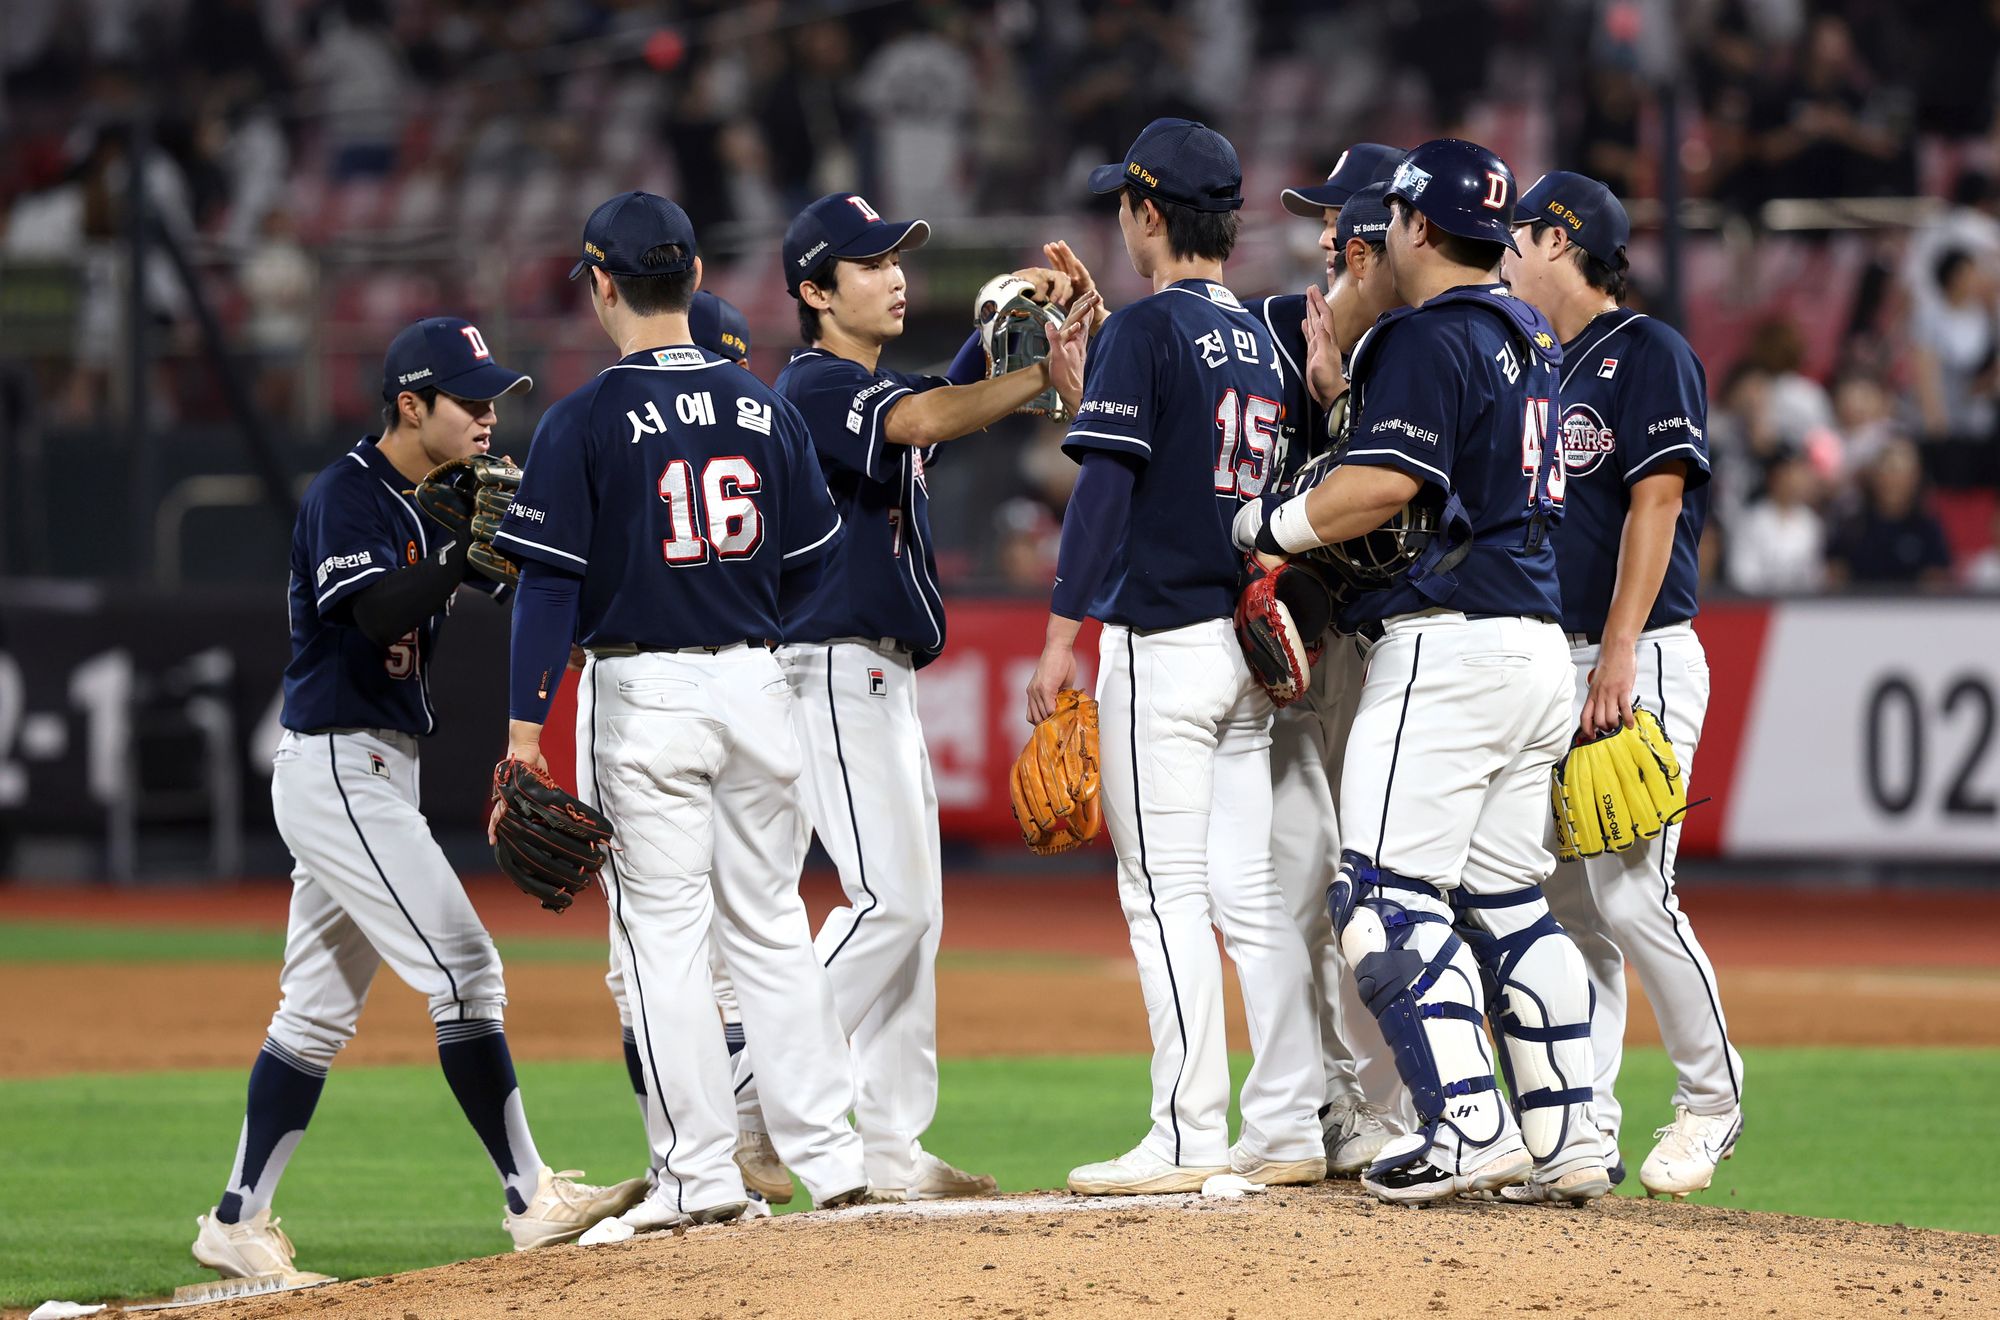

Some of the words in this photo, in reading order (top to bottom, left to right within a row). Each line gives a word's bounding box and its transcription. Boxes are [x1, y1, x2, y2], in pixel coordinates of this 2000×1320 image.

[1129, 161, 1141, 176] KB
[1141, 169, 1158, 188] Pay
[1482, 172, 1508, 210] D
[1548, 200, 1563, 215] KB
[1563, 210, 1583, 230] Pay
[593, 245, 605, 262] Pay
[460, 326, 489, 360] D
[722, 332, 733, 345] KB
[734, 337, 747, 354] Pay
[1214, 387, 1281, 504] 15
[1371, 418, 1439, 445] 두산에너빌리티
[657, 455, 765, 567] 16
[385, 627, 420, 681] 5
[1602, 793, 1622, 841] PRO-SPECS
